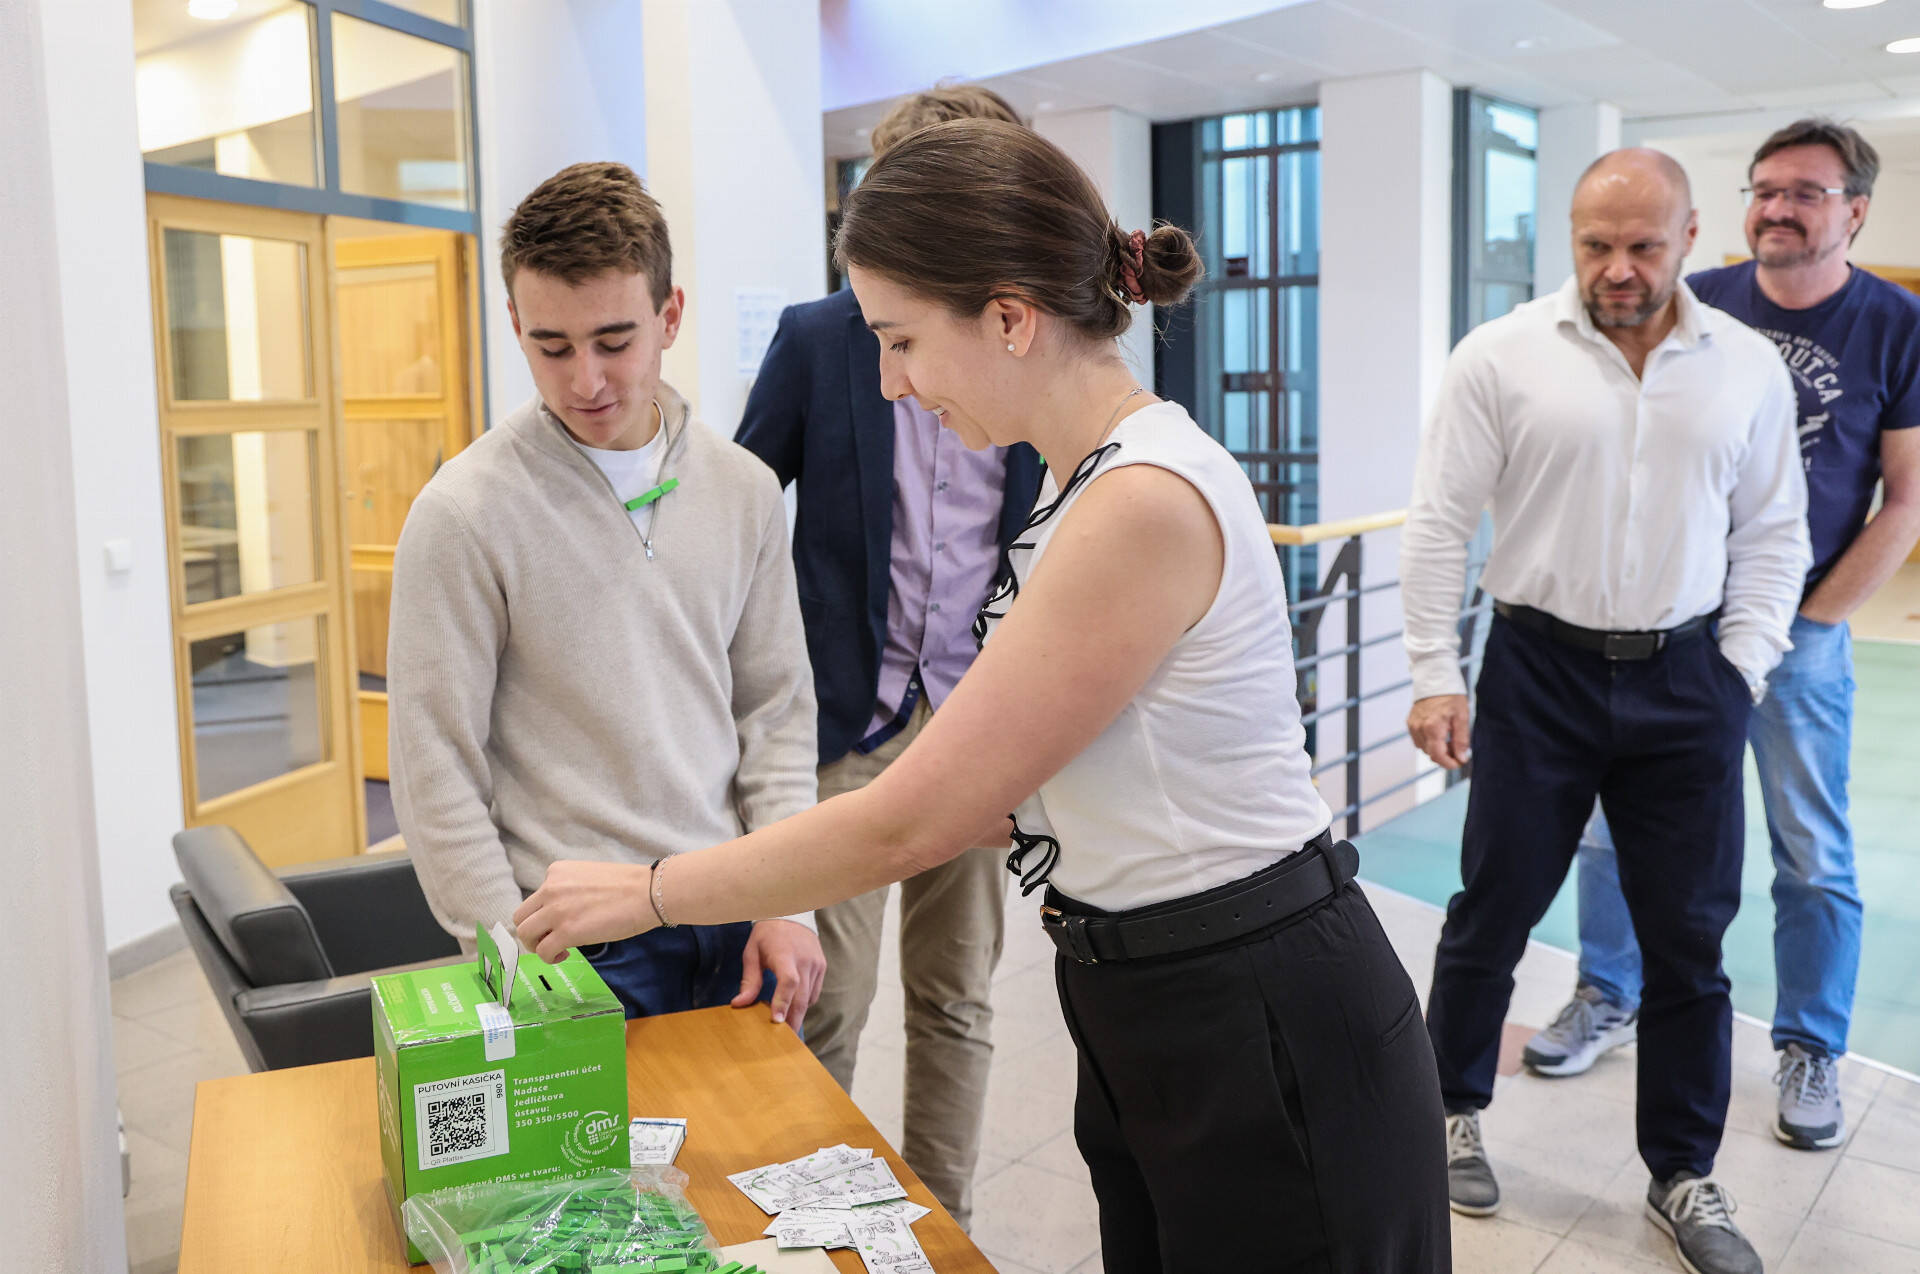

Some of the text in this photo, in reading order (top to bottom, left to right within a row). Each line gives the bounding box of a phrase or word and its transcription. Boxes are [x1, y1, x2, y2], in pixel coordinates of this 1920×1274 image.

[418, 1072, 502, 1094] PUTOVNÍ KASIČKA
[513, 1063, 602, 1086] Transparentní účet
[513, 1085, 549, 1097] Nadace
[514, 1092, 564, 1108] Jedličkova
[514, 1105, 550, 1118] ústavu:
[515, 1110, 579, 1129] 350 350/5500
[585, 1114, 619, 1135] dms
[495, 1173, 517, 1184] DMS
[519, 1171, 530, 1179] ve
[533, 1166, 561, 1177] tvaru:
[575, 1169, 587, 1177] 87
